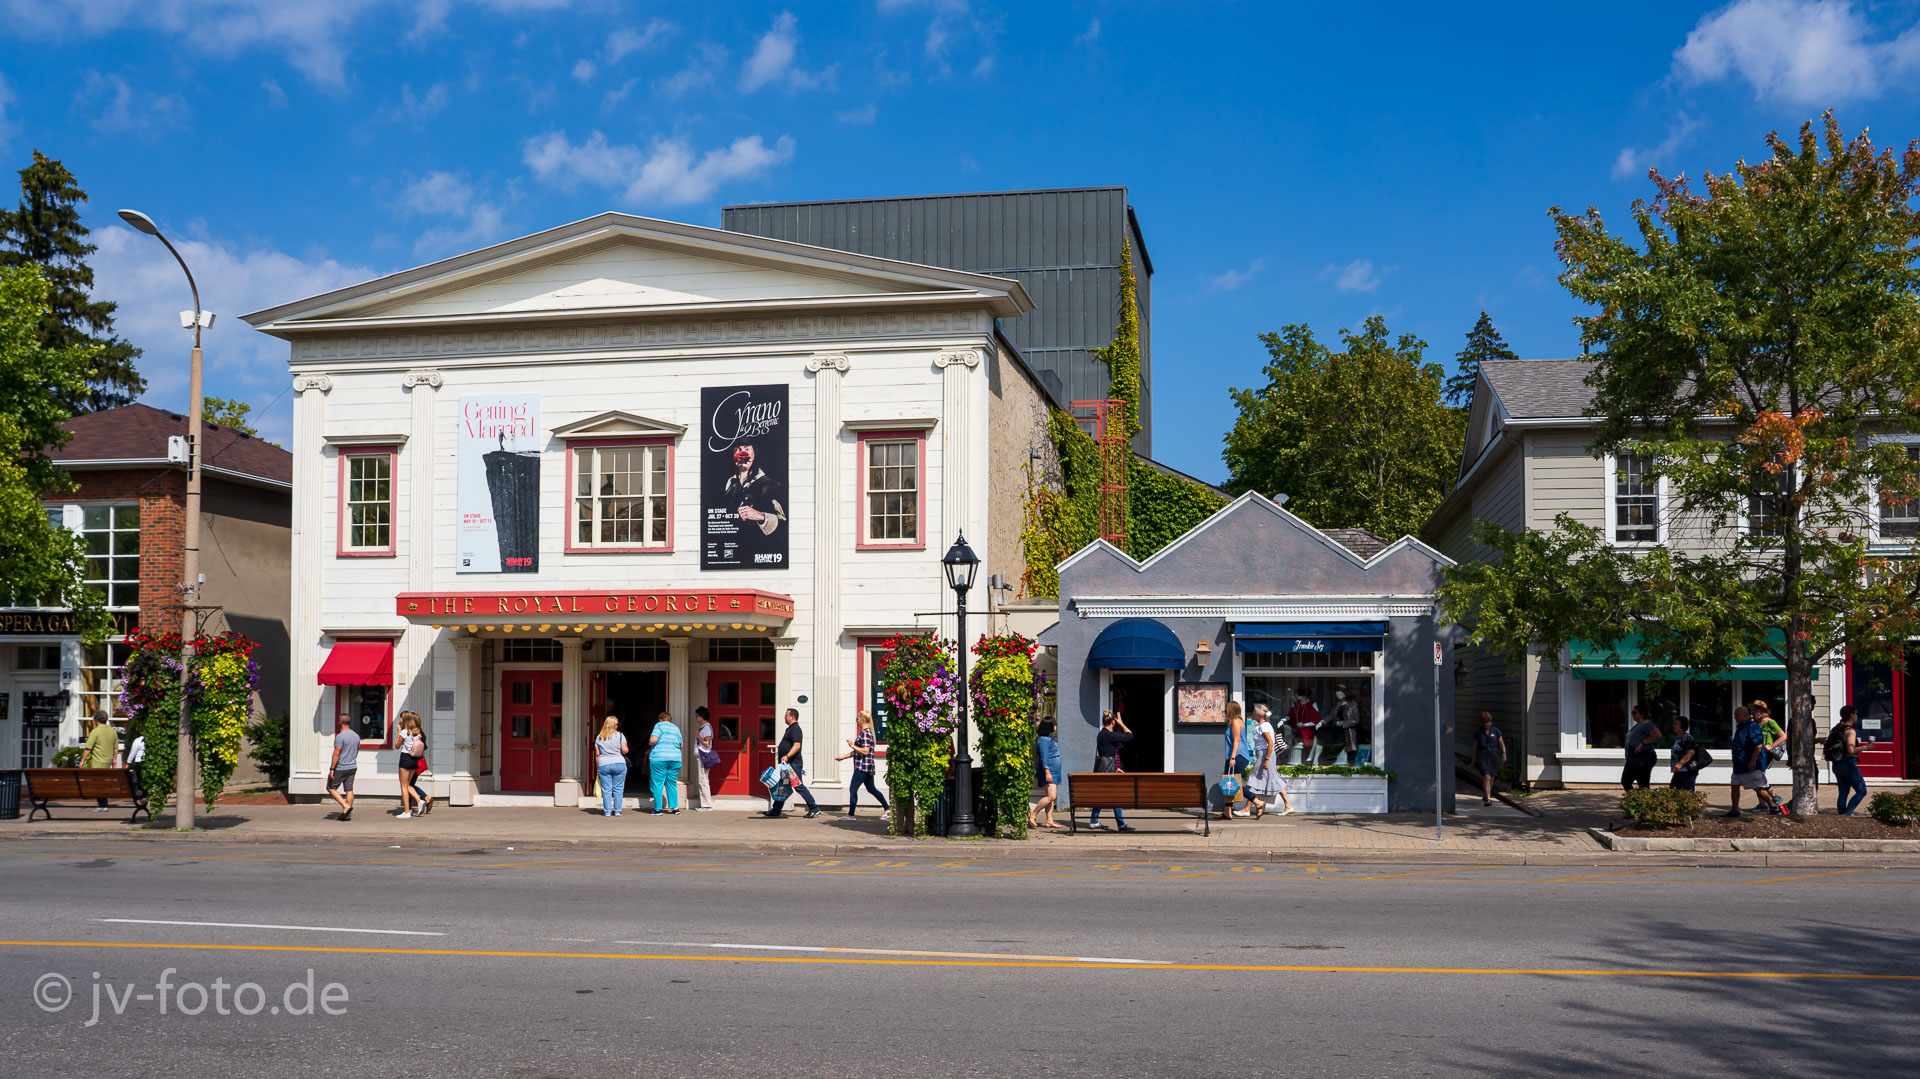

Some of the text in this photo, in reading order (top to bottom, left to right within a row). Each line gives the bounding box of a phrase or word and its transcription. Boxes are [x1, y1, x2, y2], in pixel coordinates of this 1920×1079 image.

[464, 400, 527, 424] Getting
[708, 390, 781, 452] Cyrano
[464, 417, 534, 439] Married
[524, 557, 532, 566] 19
[773, 553, 782, 563] 19
[426, 594, 720, 614] THE ROYAL GEORGE
[62, 671, 72, 680] 91
